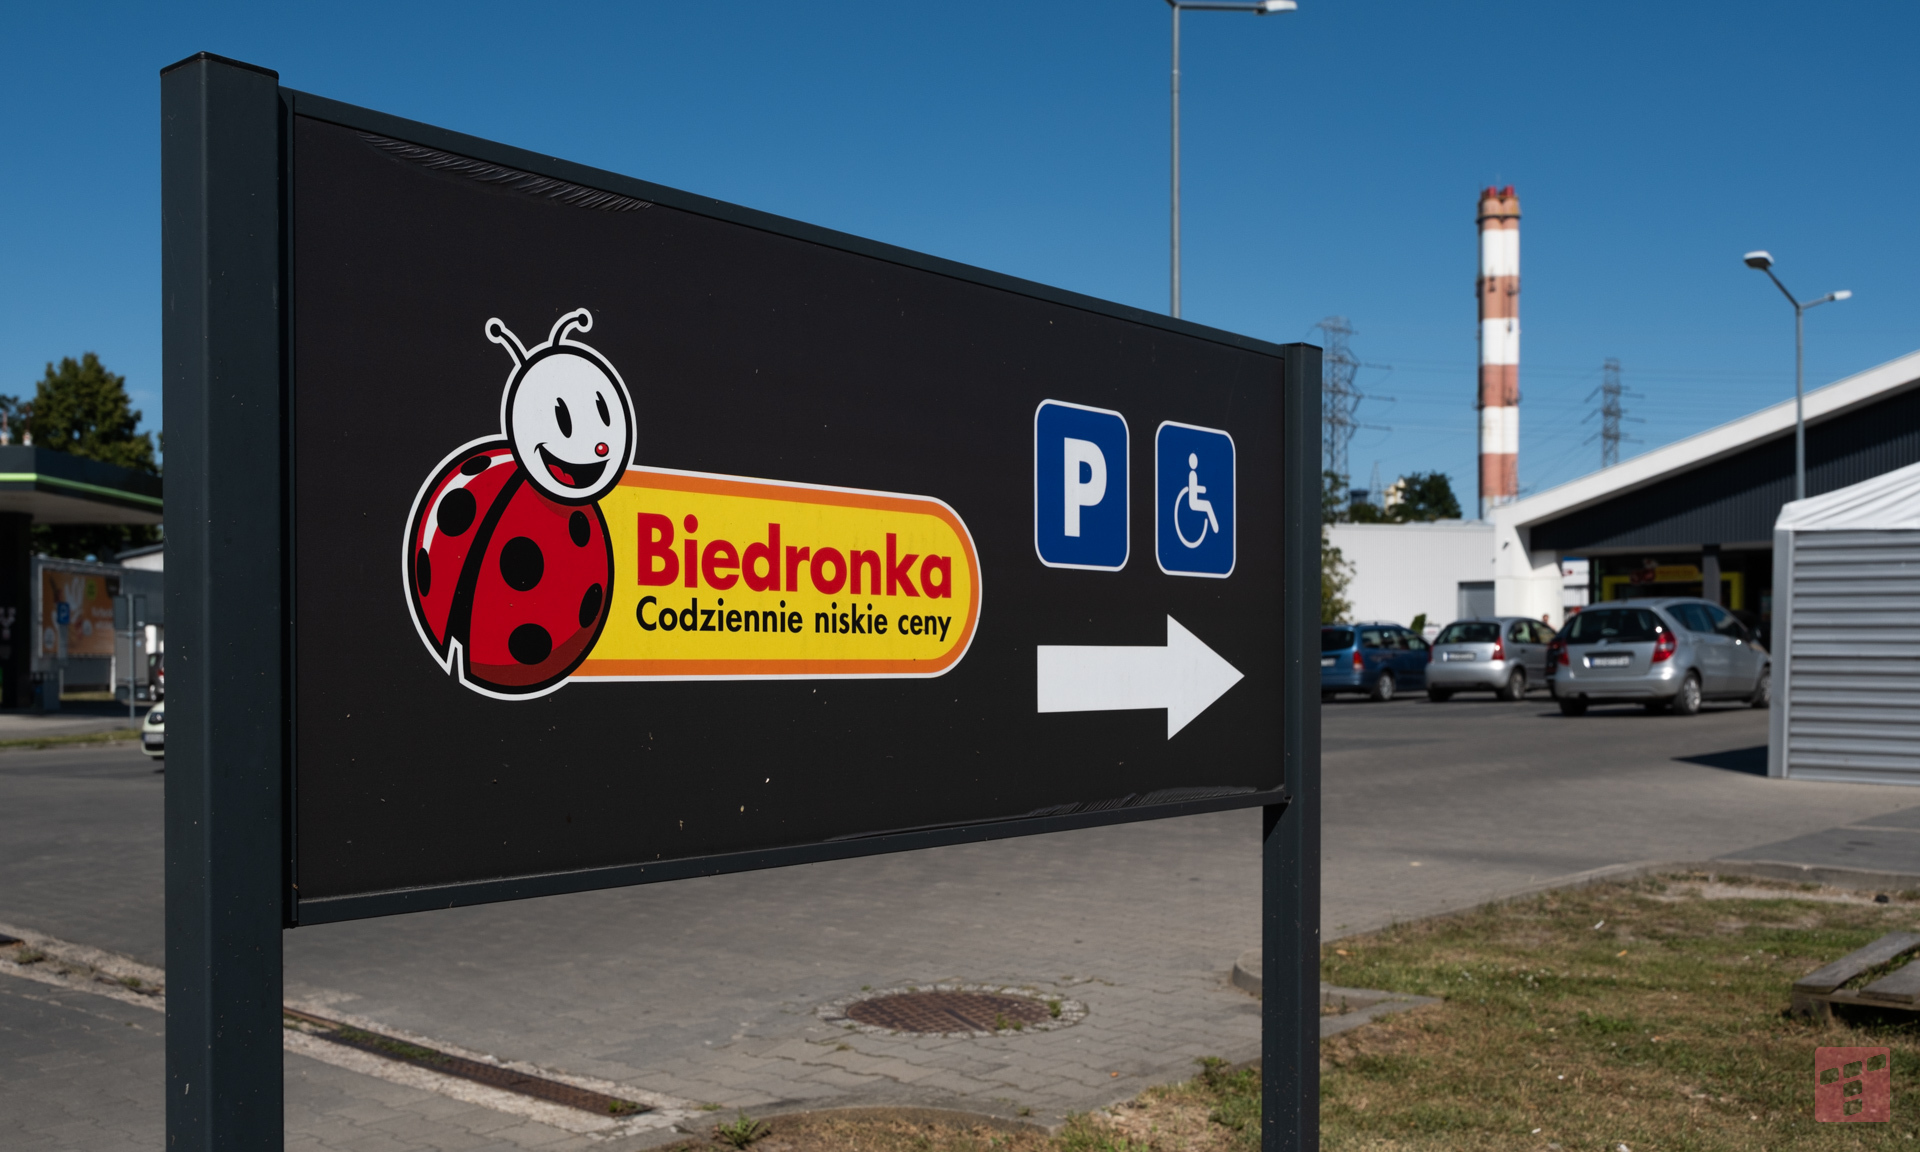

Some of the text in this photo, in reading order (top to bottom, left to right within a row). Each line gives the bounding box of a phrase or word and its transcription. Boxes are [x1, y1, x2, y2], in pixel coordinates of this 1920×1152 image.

[1064, 437, 1107, 537] P
[637, 512, 952, 599] Biedronka
[636, 595, 952, 642] Codziennie niskie ceny
